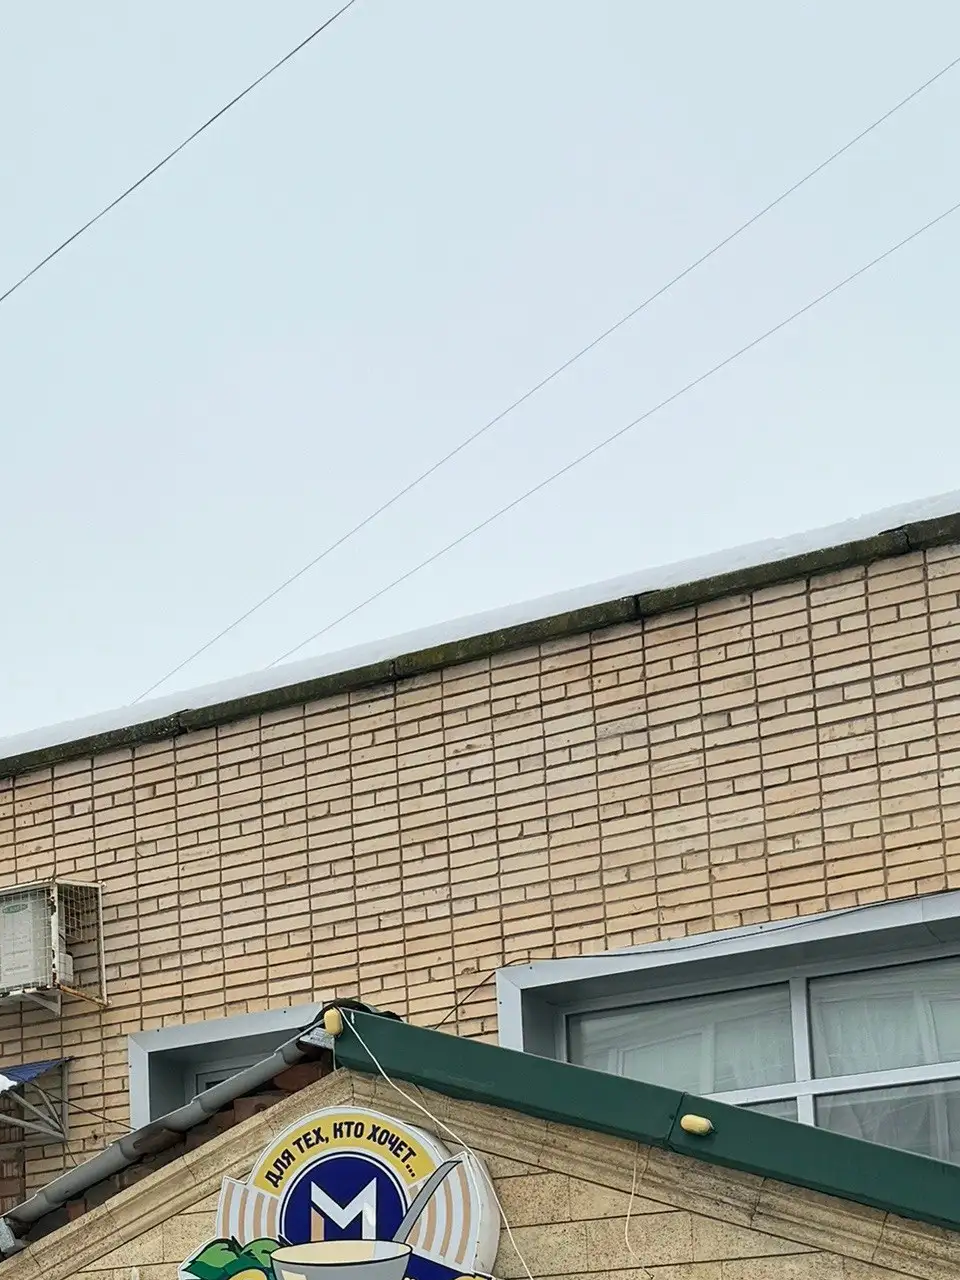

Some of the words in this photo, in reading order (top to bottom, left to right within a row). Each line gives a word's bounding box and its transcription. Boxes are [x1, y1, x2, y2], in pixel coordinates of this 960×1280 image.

[264, 1148, 297, 1189] ДЛЯ
[292, 1126, 330, 1154] ТЕХ,
[332, 1121, 365, 1140] КТО
[365, 1123, 418, 1179] ХОЧЕТ...
